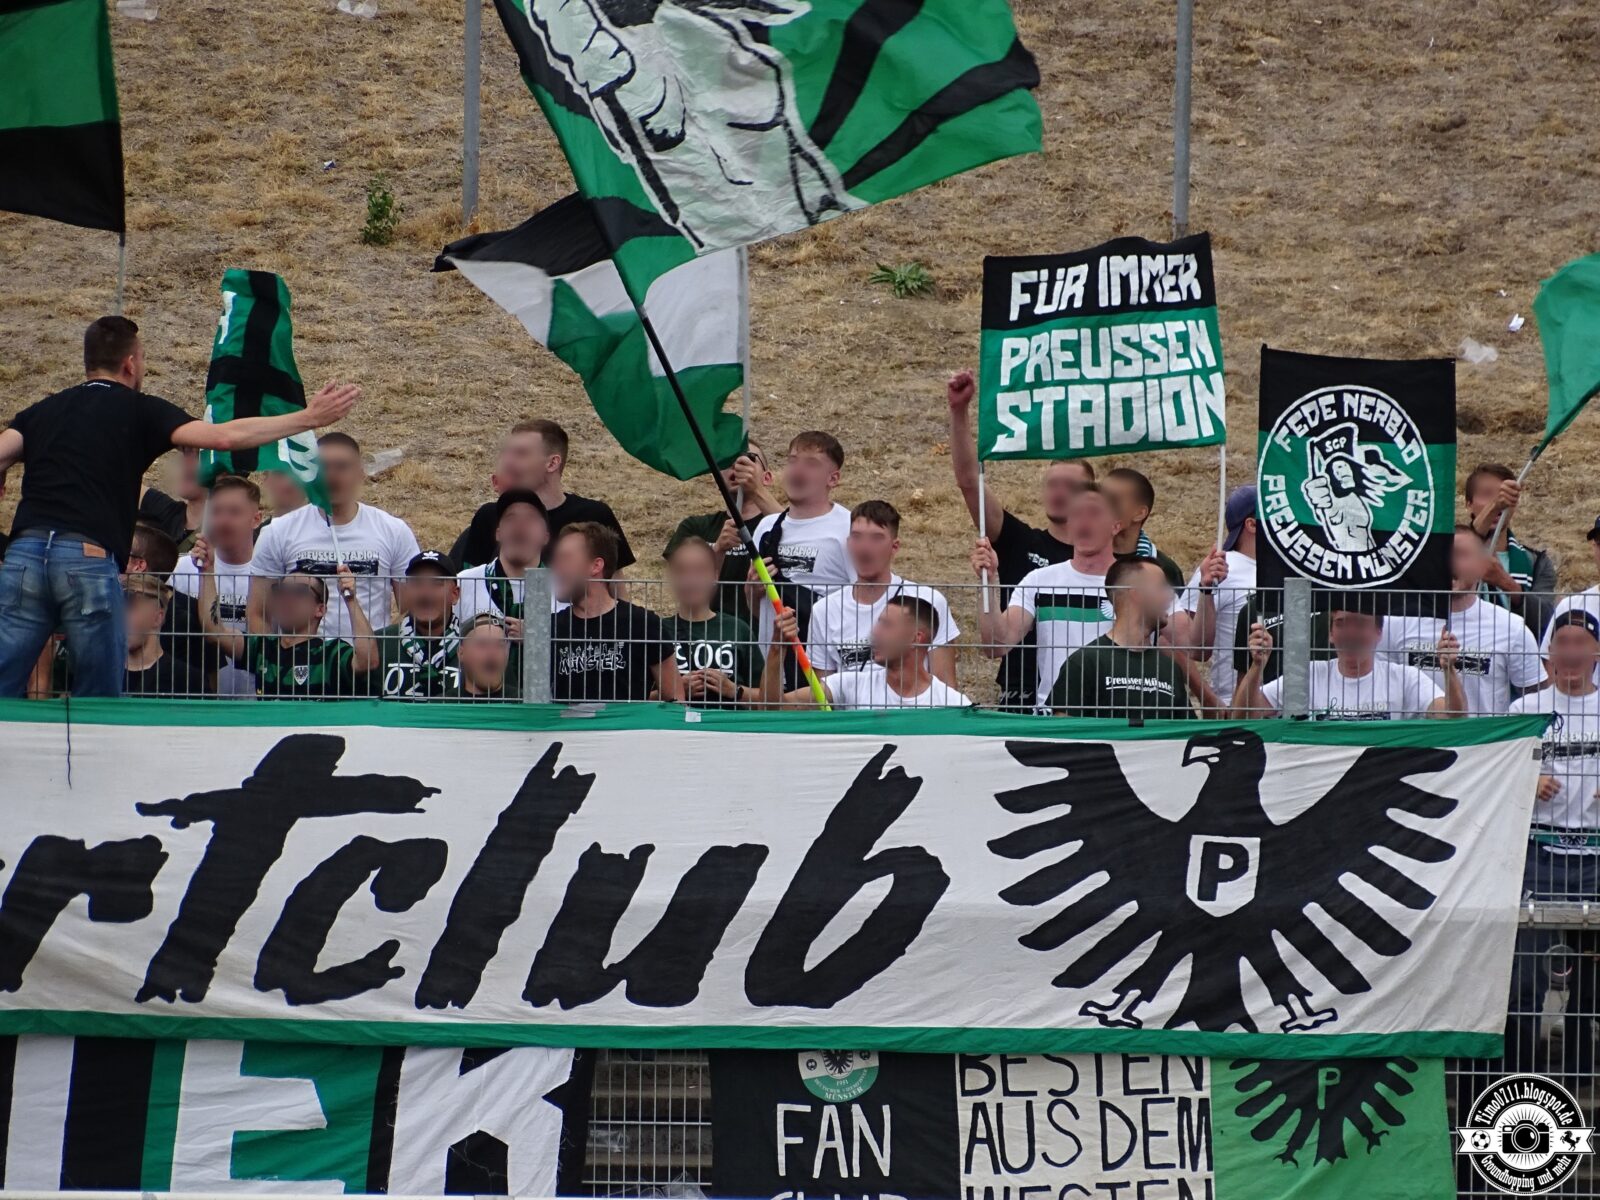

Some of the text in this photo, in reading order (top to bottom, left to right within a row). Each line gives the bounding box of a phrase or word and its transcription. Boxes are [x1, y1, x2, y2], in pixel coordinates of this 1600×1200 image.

[1009, 253, 1202, 322] FÜR IMMER
[1000, 319, 1217, 386] PREUSSEN
[991, 371, 1226, 453] STADION
[1273, 393, 1338, 453] FEDE
[1263, 474, 1430, 580] PREUSSEN MÜNSTER
[0, 733, 950, 1010] rtclub
[1197, 841, 1250, 902] P
[1317, 1067, 1341, 1110] P
[776, 1103, 892, 1179] FAN
[964, 1096, 1214, 1175] AUS DEM
